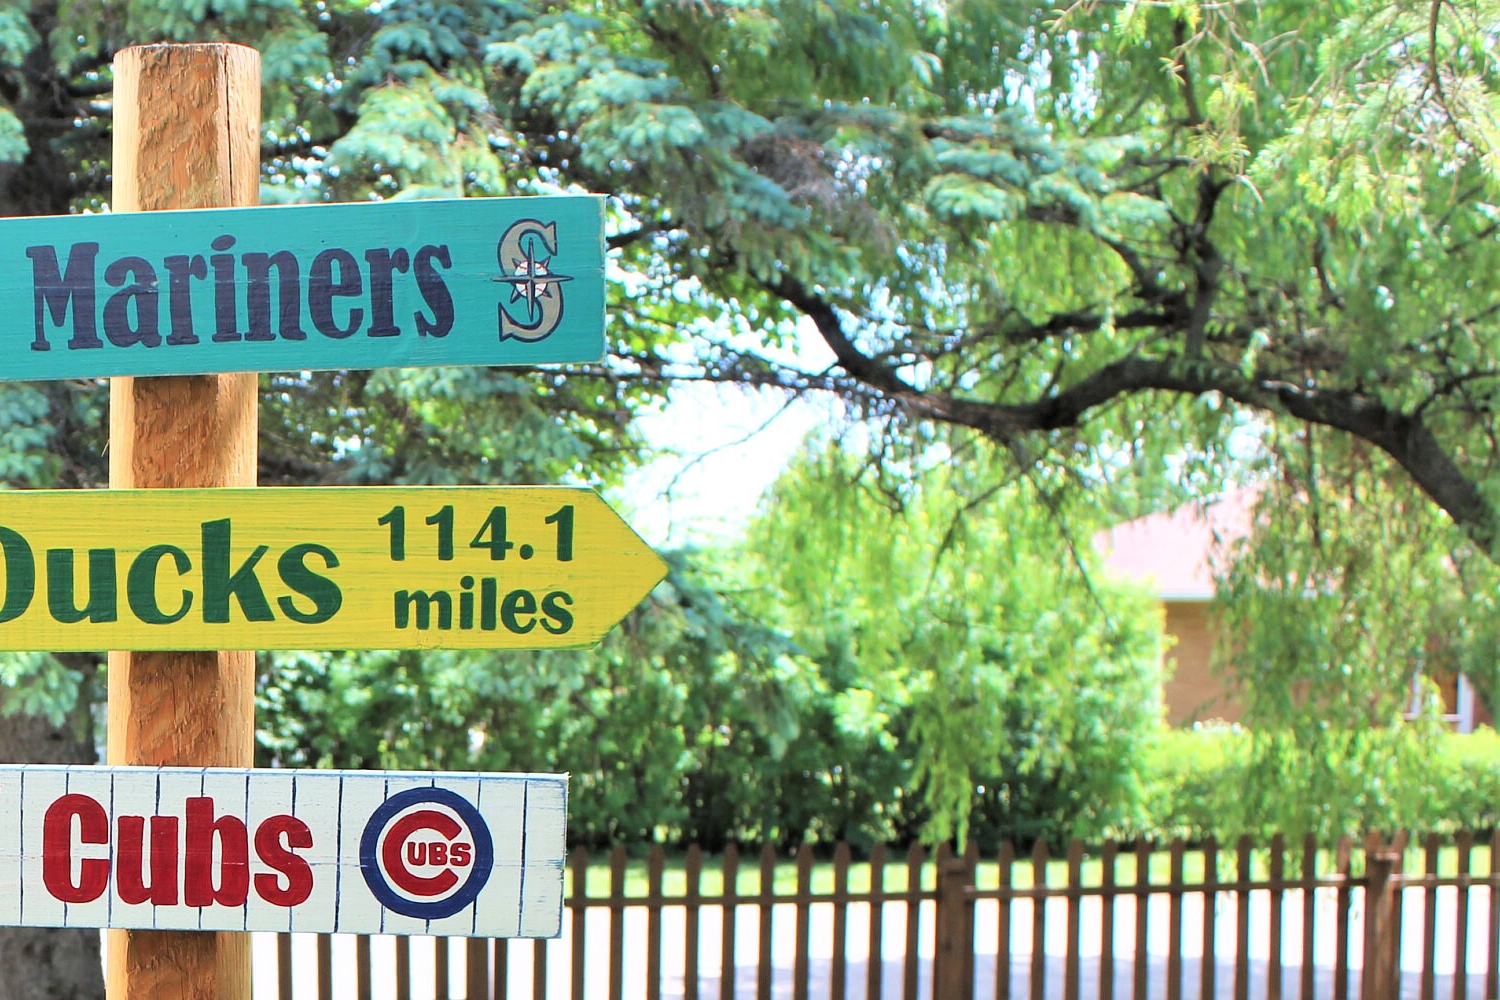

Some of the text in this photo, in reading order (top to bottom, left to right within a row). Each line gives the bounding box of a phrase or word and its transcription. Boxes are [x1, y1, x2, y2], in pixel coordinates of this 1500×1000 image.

[25, 235, 453, 351] Mariners
[377, 505, 574, 562] 114.1
[394, 577, 574, 635] miles
[42, 793, 314, 908] Cubs
